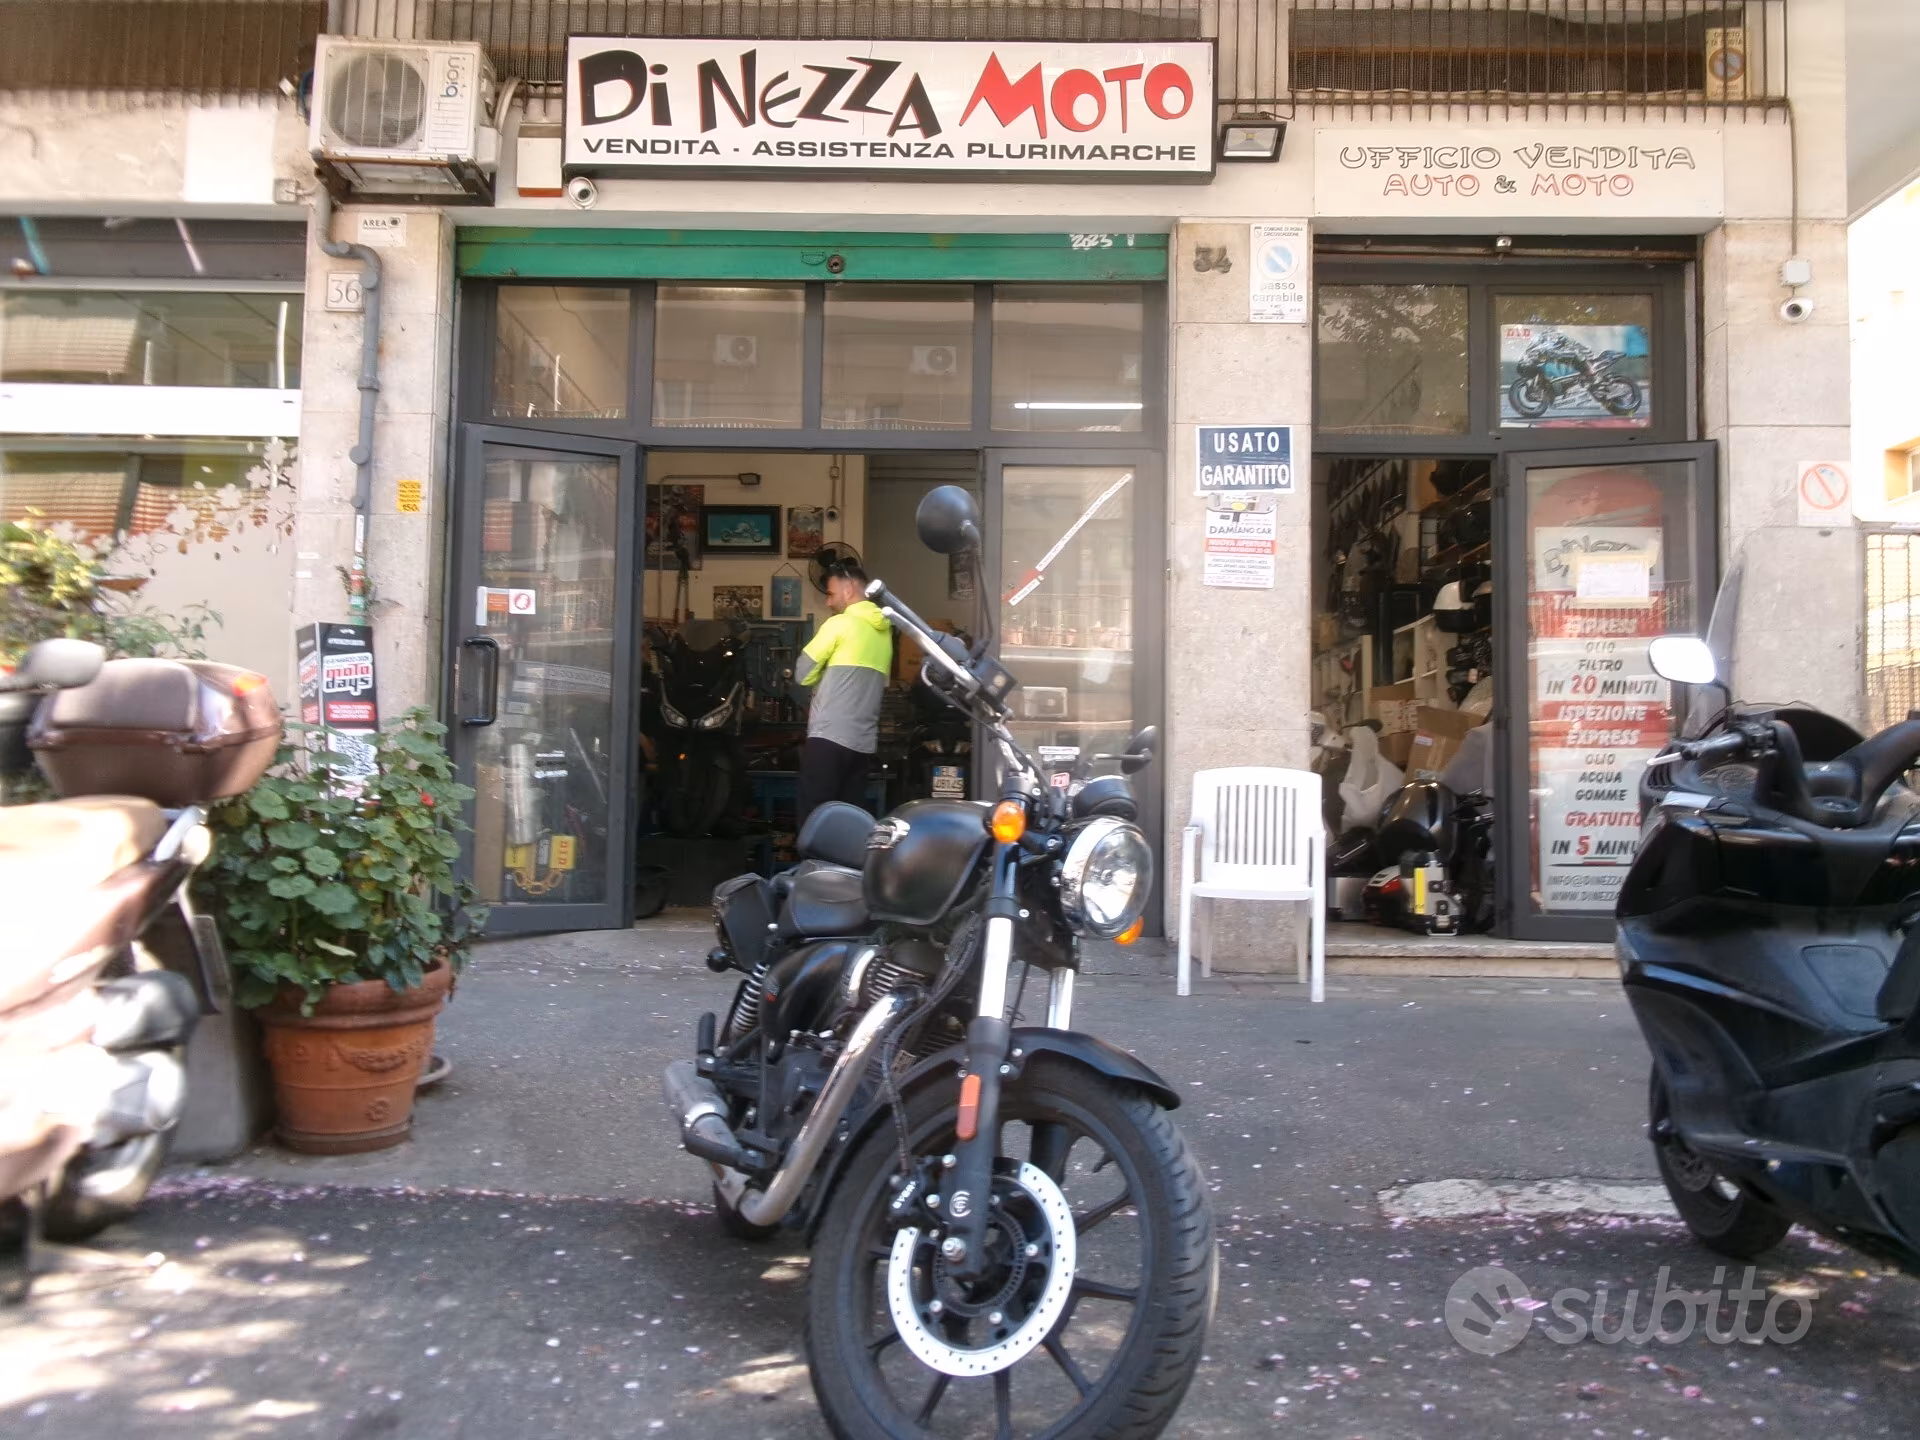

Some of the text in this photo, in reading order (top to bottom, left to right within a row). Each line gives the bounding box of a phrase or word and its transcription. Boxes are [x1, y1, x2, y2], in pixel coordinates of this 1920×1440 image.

[958, 50, 1194, 140] MOTO
[582, 138, 721, 155] VENDITA
[752, 140, 954, 158] ASSISTENZA
[967, 142, 1196, 161] PLURIMARCHE
[1339, 143, 1696, 171] UFFICIO VENDITA
[1382, 173, 1634, 197] AUTO & MOTO
[362, 219, 388, 227] AREA
[329, 278, 360, 304] 36
[1252, 292, 1304, 303] carrabile
[1213, 431, 1280, 453] USATO
[1201, 463, 1290, 486] GARANTITO
[1256, 527, 1272, 535] CAR
[1565, 615, 1638, 635] EXPRESS
[1585, 641, 1615, 654] OLIO
[326, 664, 370, 679] moto
[1578, 659, 1623, 672] FILTRO
[326, 676, 370, 693] days
[1546, 674, 1659, 695] IN 20 MINUTI
[1558, 705, 1649, 722] ISPEZIONE
[1566, 729, 1641, 745] EXPRESS
[1585, 753, 1616, 766] OLIO
[1578, 771, 1623, 784] ACQUA
[1575, 789, 1629, 801] GOMME
[1551, 835, 1638, 855] IN 5 MINU
